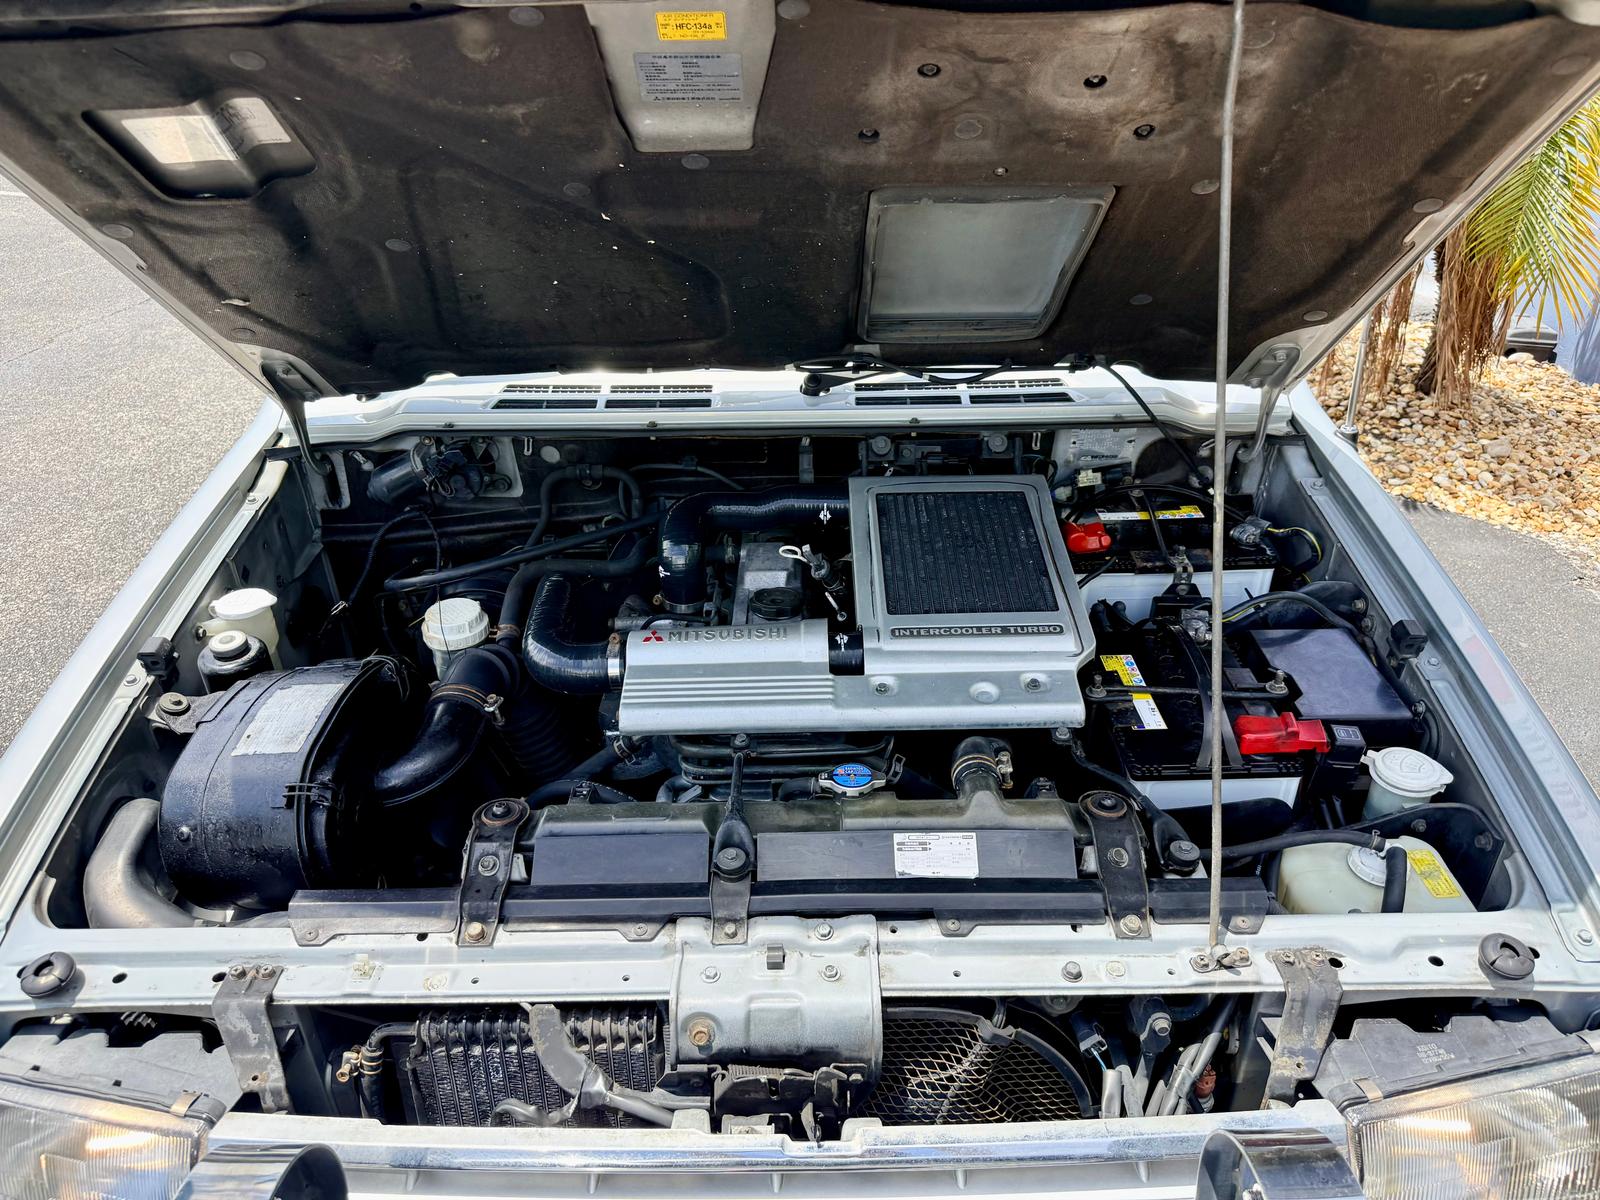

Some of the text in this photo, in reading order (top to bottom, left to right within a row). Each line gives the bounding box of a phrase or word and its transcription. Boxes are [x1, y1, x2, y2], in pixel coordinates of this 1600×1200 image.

[675, 22, 713, 30] HFC-134a
[668, 628, 789, 643] MITSUBISHI
[894, 625, 1061, 637] INTERCOOLER TURBO
